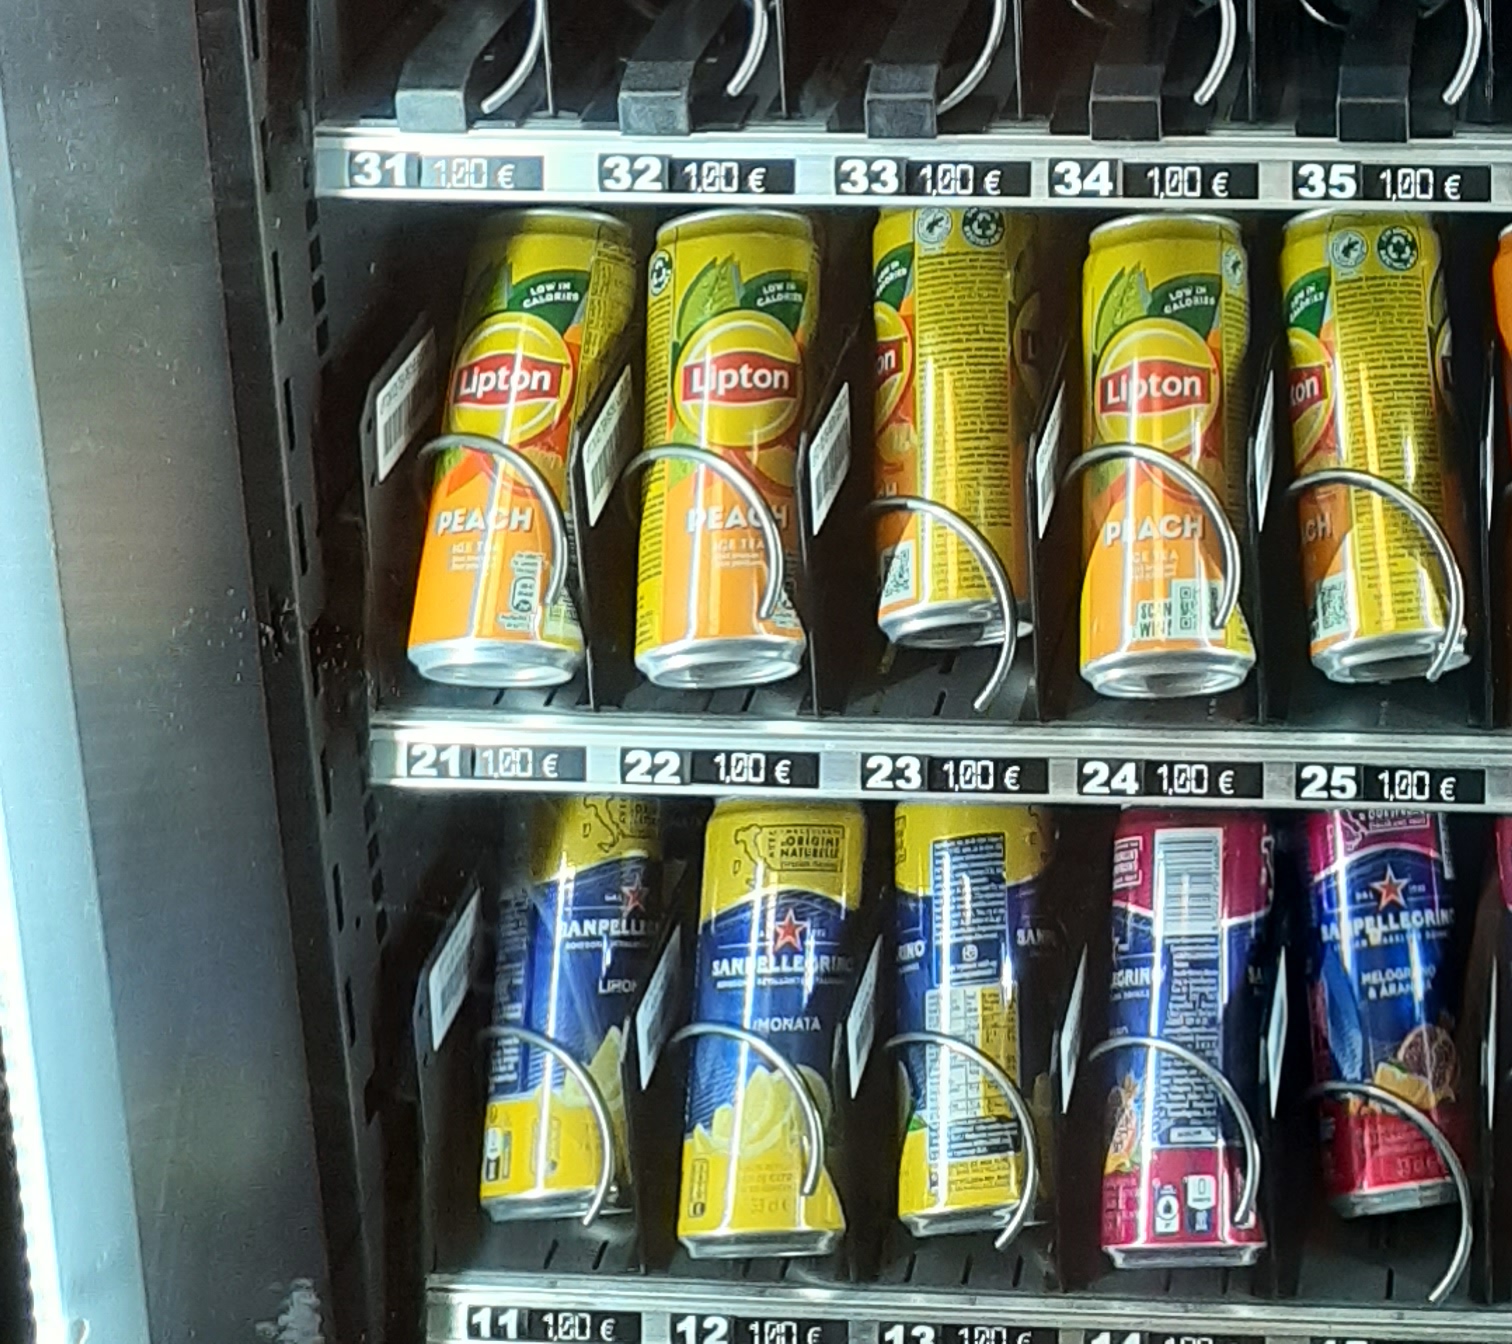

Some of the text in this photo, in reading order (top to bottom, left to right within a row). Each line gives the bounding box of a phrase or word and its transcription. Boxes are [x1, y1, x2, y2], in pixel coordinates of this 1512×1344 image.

[352, 153, 409, 187] 31
[602, 156, 663, 190] 32
[839, 159, 900, 194] 33
[1053, 160, 1113, 196] 34
[1297, 164, 1358, 199] 35
[1380, 168, 1461, 202] 1,00 €
[522, 291, 580, 309] CALORIES
[529, 280, 572, 296] LOW IN
[1168, 287, 1193, 302] LOW
[460, 365, 551, 399] Lipton
[692, 363, 789, 396] Lipton
[1105, 372, 1203, 405] Lipton
[435, 506, 533, 538] PEACH
[410, 745, 461, 777] 21
[623, 751, 681, 783] 22
[714, 753, 792, 785] 1,00 €
[865, 756, 922, 790] 23
[1082, 762, 1139, 794] 24
[1300, 766, 1358, 798] 25
[470, 1308, 520, 1340] 11
[601, 1318, 616, 1342] €
[676, 1316, 729, 1344] 12
